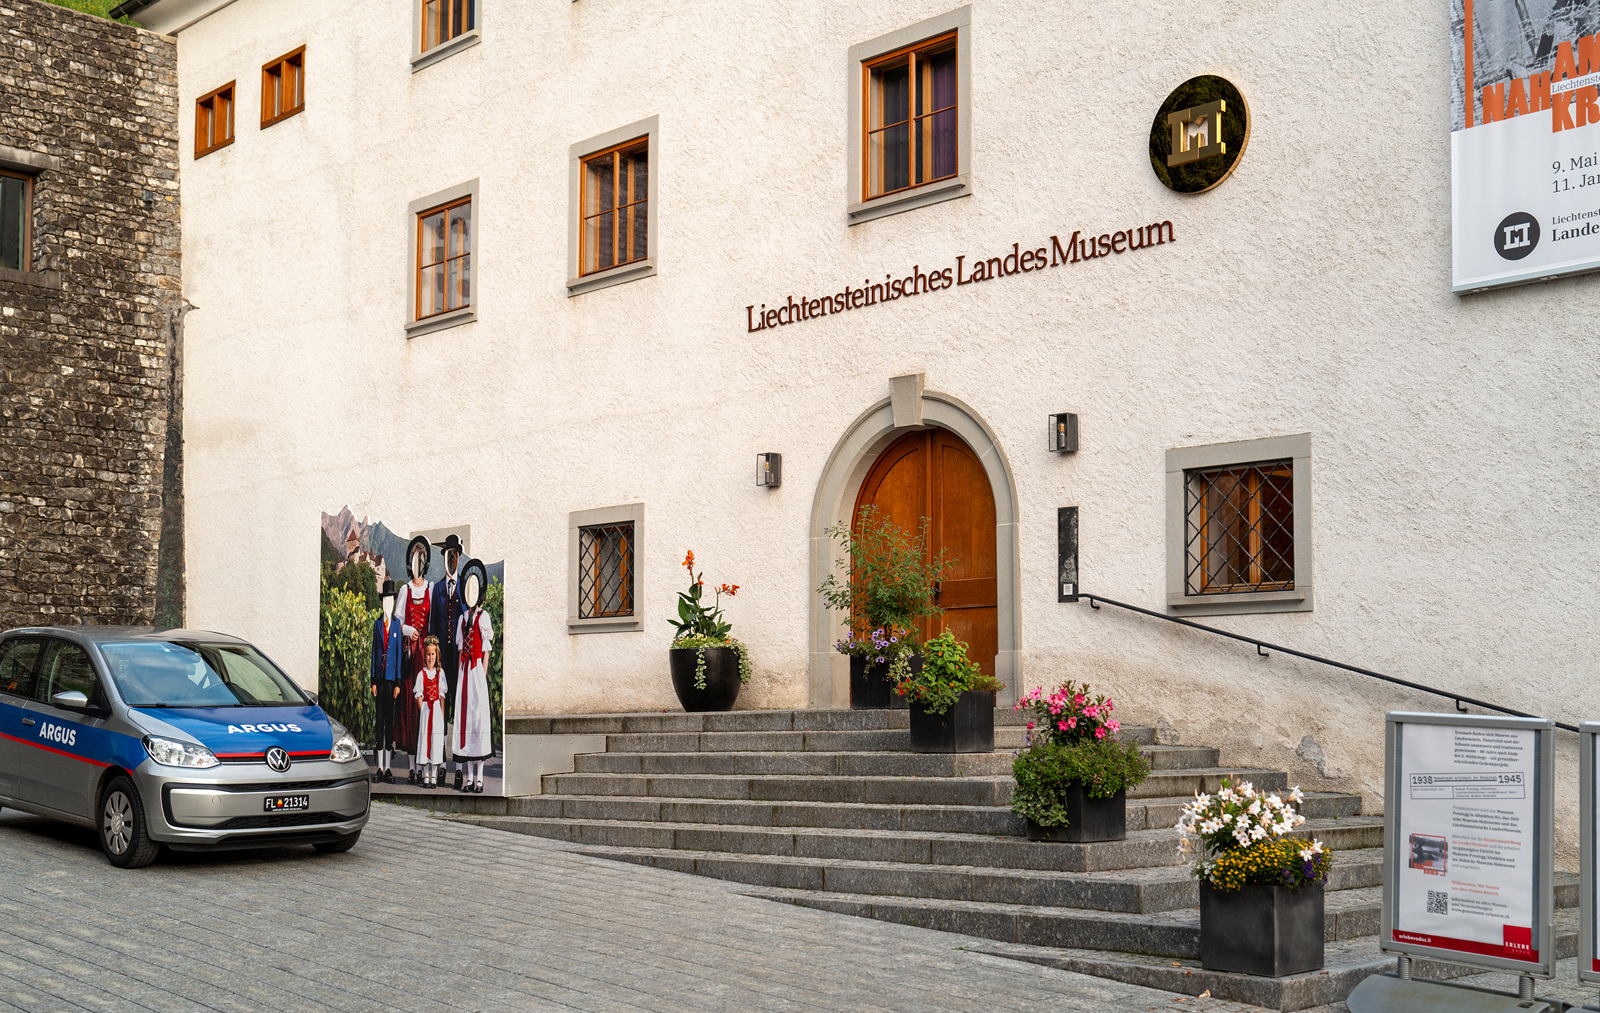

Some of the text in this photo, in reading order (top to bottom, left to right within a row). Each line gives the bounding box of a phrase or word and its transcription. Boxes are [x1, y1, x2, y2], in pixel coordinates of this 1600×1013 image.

[1483, 70, 1551, 125] NAH
[1552, 85, 1600, 133] KR
[1552, 152, 1598, 174] 9. Mai
[1552, 178, 1575, 193] 11.
[1552, 222, 1600, 242] Lande
[746, 265, 953, 333] Liechtensteinisches
[39, 722, 77, 746] ARGUS
[228, 724, 302, 734] ARGUS
[1413, 776, 1434, 785] 1938
[1498, 774, 1522, 784] 1945
[266, 797, 308, 808] FL 21314
[1399, 934, 1432, 943] erlebevaduz.li
[1505, 942, 1530, 950] ERLEBE
